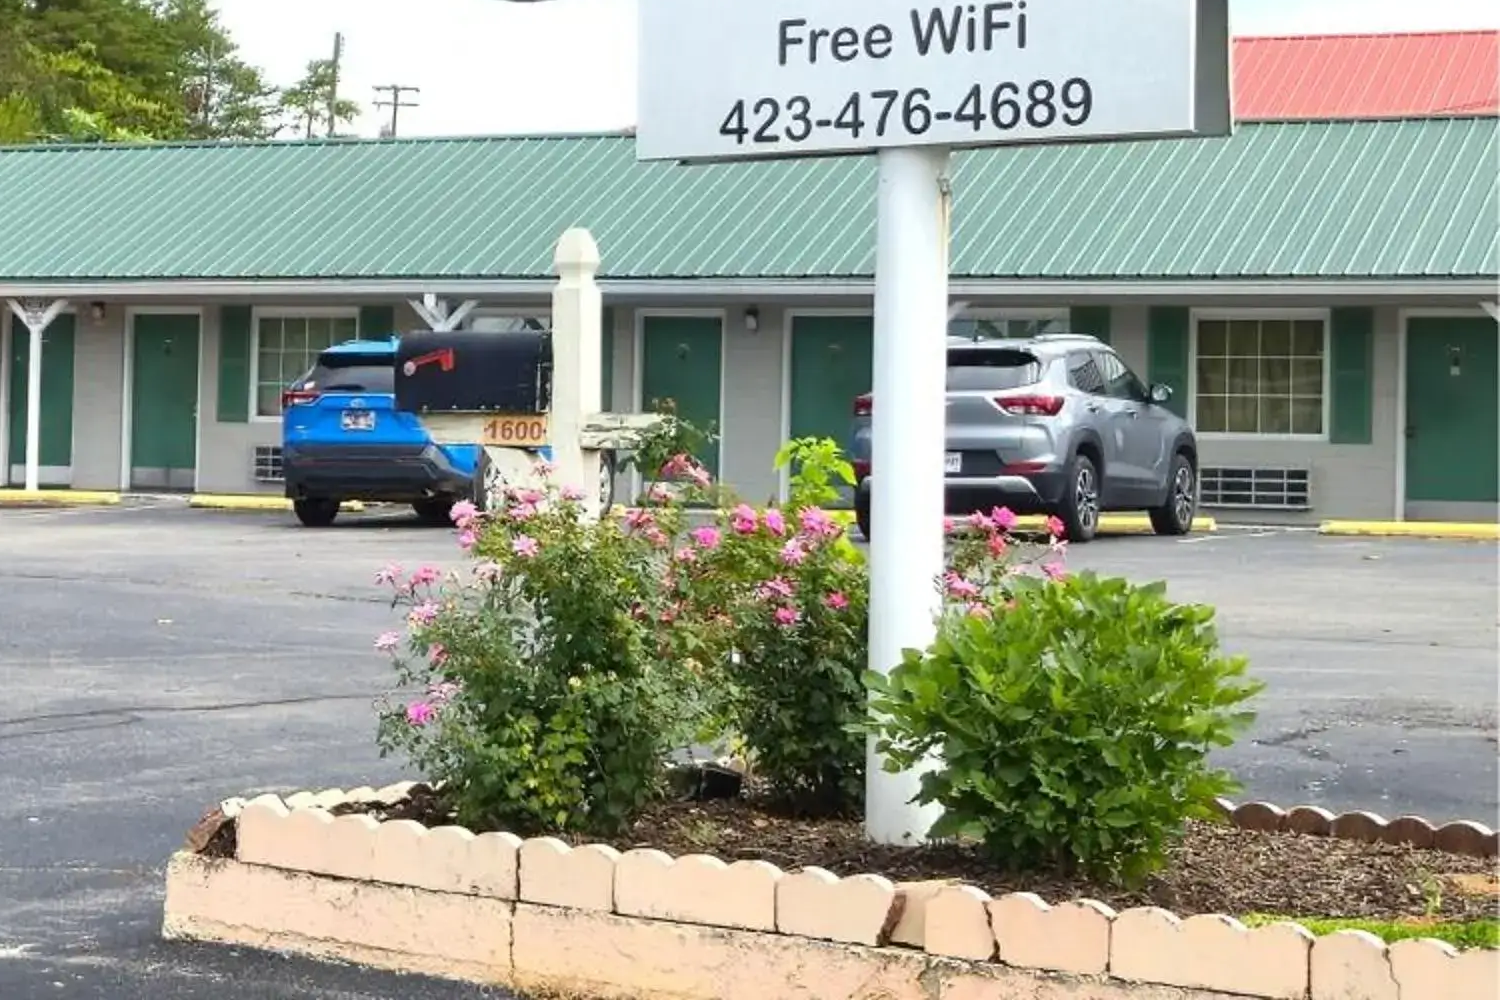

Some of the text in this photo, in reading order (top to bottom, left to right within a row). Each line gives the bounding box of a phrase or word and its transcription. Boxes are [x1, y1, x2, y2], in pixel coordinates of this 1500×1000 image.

[777, 1, 1028, 66] Free WiFi
[719, 77, 1094, 146] 423-476-4689
[488, 420, 542, 440] 1600
